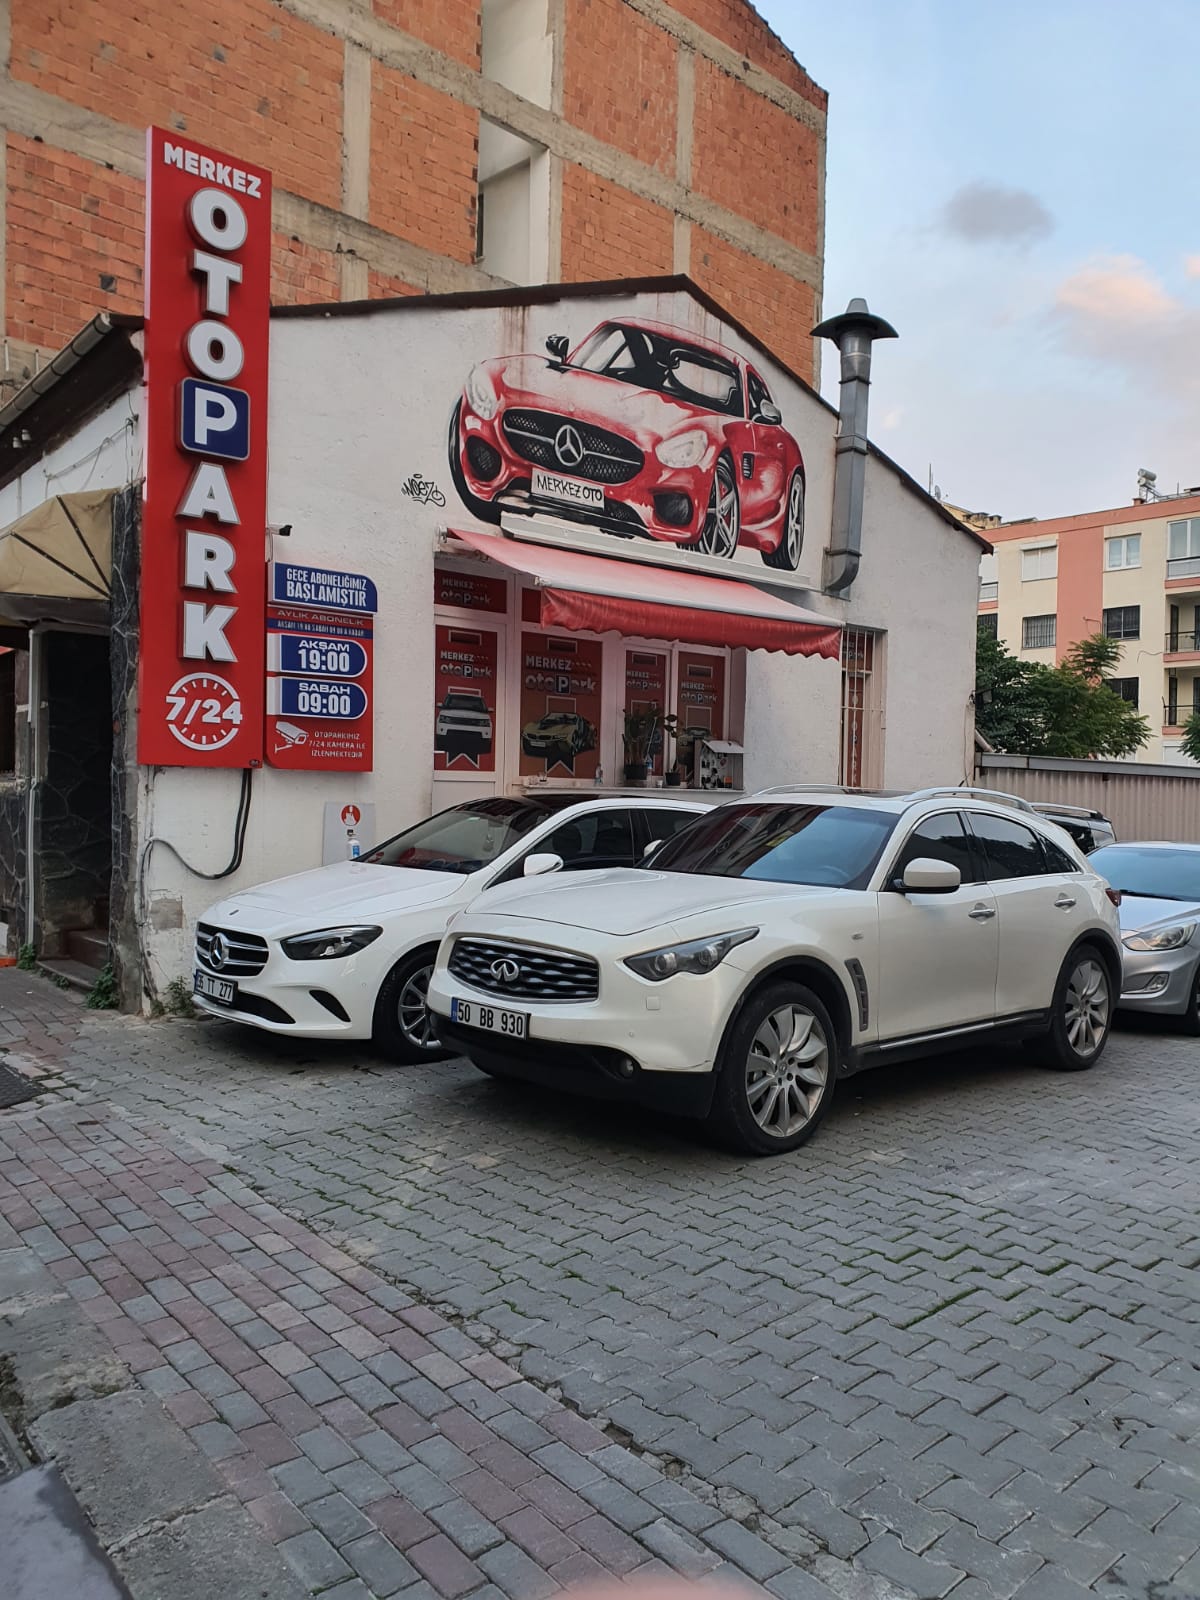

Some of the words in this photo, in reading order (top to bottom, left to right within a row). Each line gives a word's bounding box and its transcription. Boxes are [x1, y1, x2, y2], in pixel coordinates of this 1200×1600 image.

[164, 142, 261, 199] MERKEZ
[180, 187, 248, 663] OTOPARK
[536, 475, 581, 499] MERKEZ
[582, 486, 604, 502] OTO
[286, 568, 309, 582] GECE
[286, 580, 367, 607] BAŞLAMIŞTIR
[277, 609, 309, 620] AYLIK
[298, 640, 350, 653] AKŞAM
[440, 650, 474, 661] MERKEZ
[298, 649, 350, 673] 19:00
[525, 655, 572, 671] MERKEZ
[298, 682, 350, 695] SABAH
[165, 695, 243, 725] 7/24
[298, 692, 350, 715] 09:00
[326, 741, 355, 749] KAMERA
[207, 978, 215, 994] TT
[219, 982, 232, 1000] 277
[457, 1002, 471, 1023] 50
[479, 1007, 494, 1028] BB
[501, 1012, 523, 1036] 930
